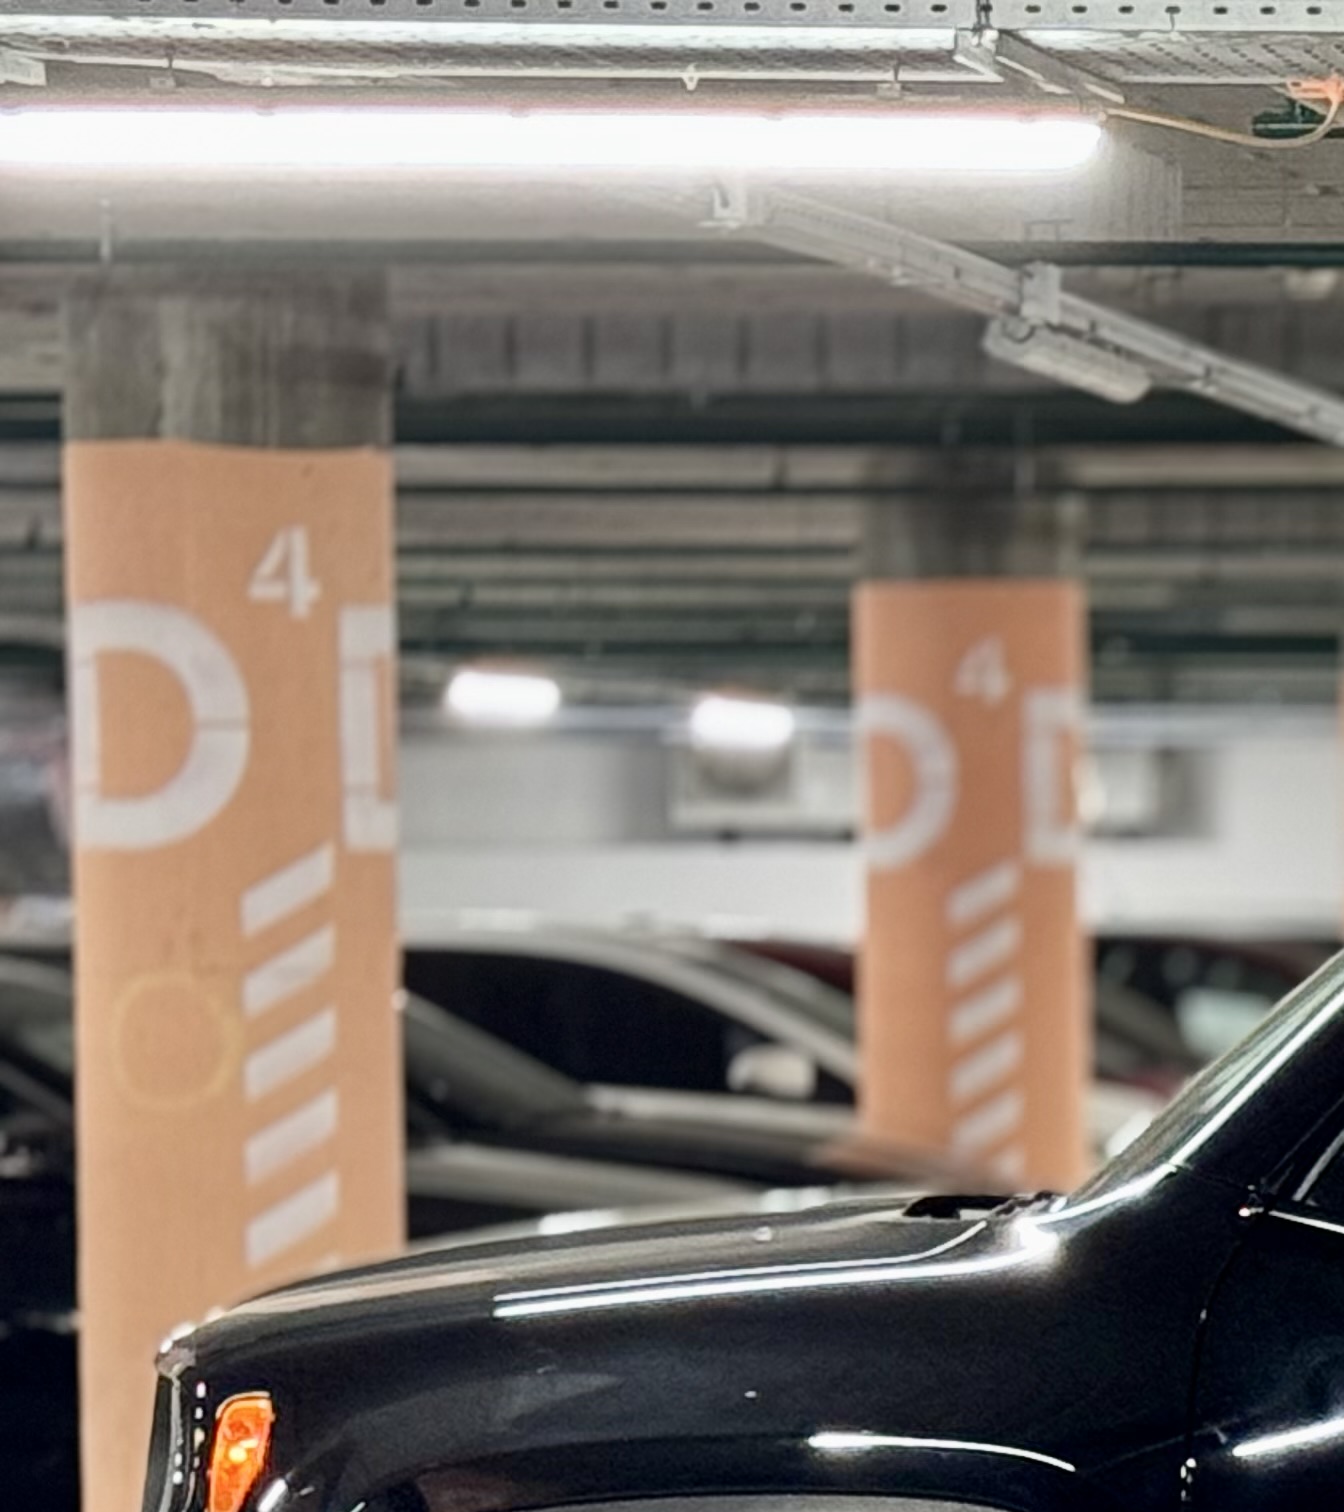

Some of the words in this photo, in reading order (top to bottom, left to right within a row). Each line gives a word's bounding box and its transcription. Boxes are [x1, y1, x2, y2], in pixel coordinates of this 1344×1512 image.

[248, 525, 321, 620] 4
[68, 597, 251, 851] D
[953, 634, 1012, 706] 4
[857, 690, 959, 872] D
